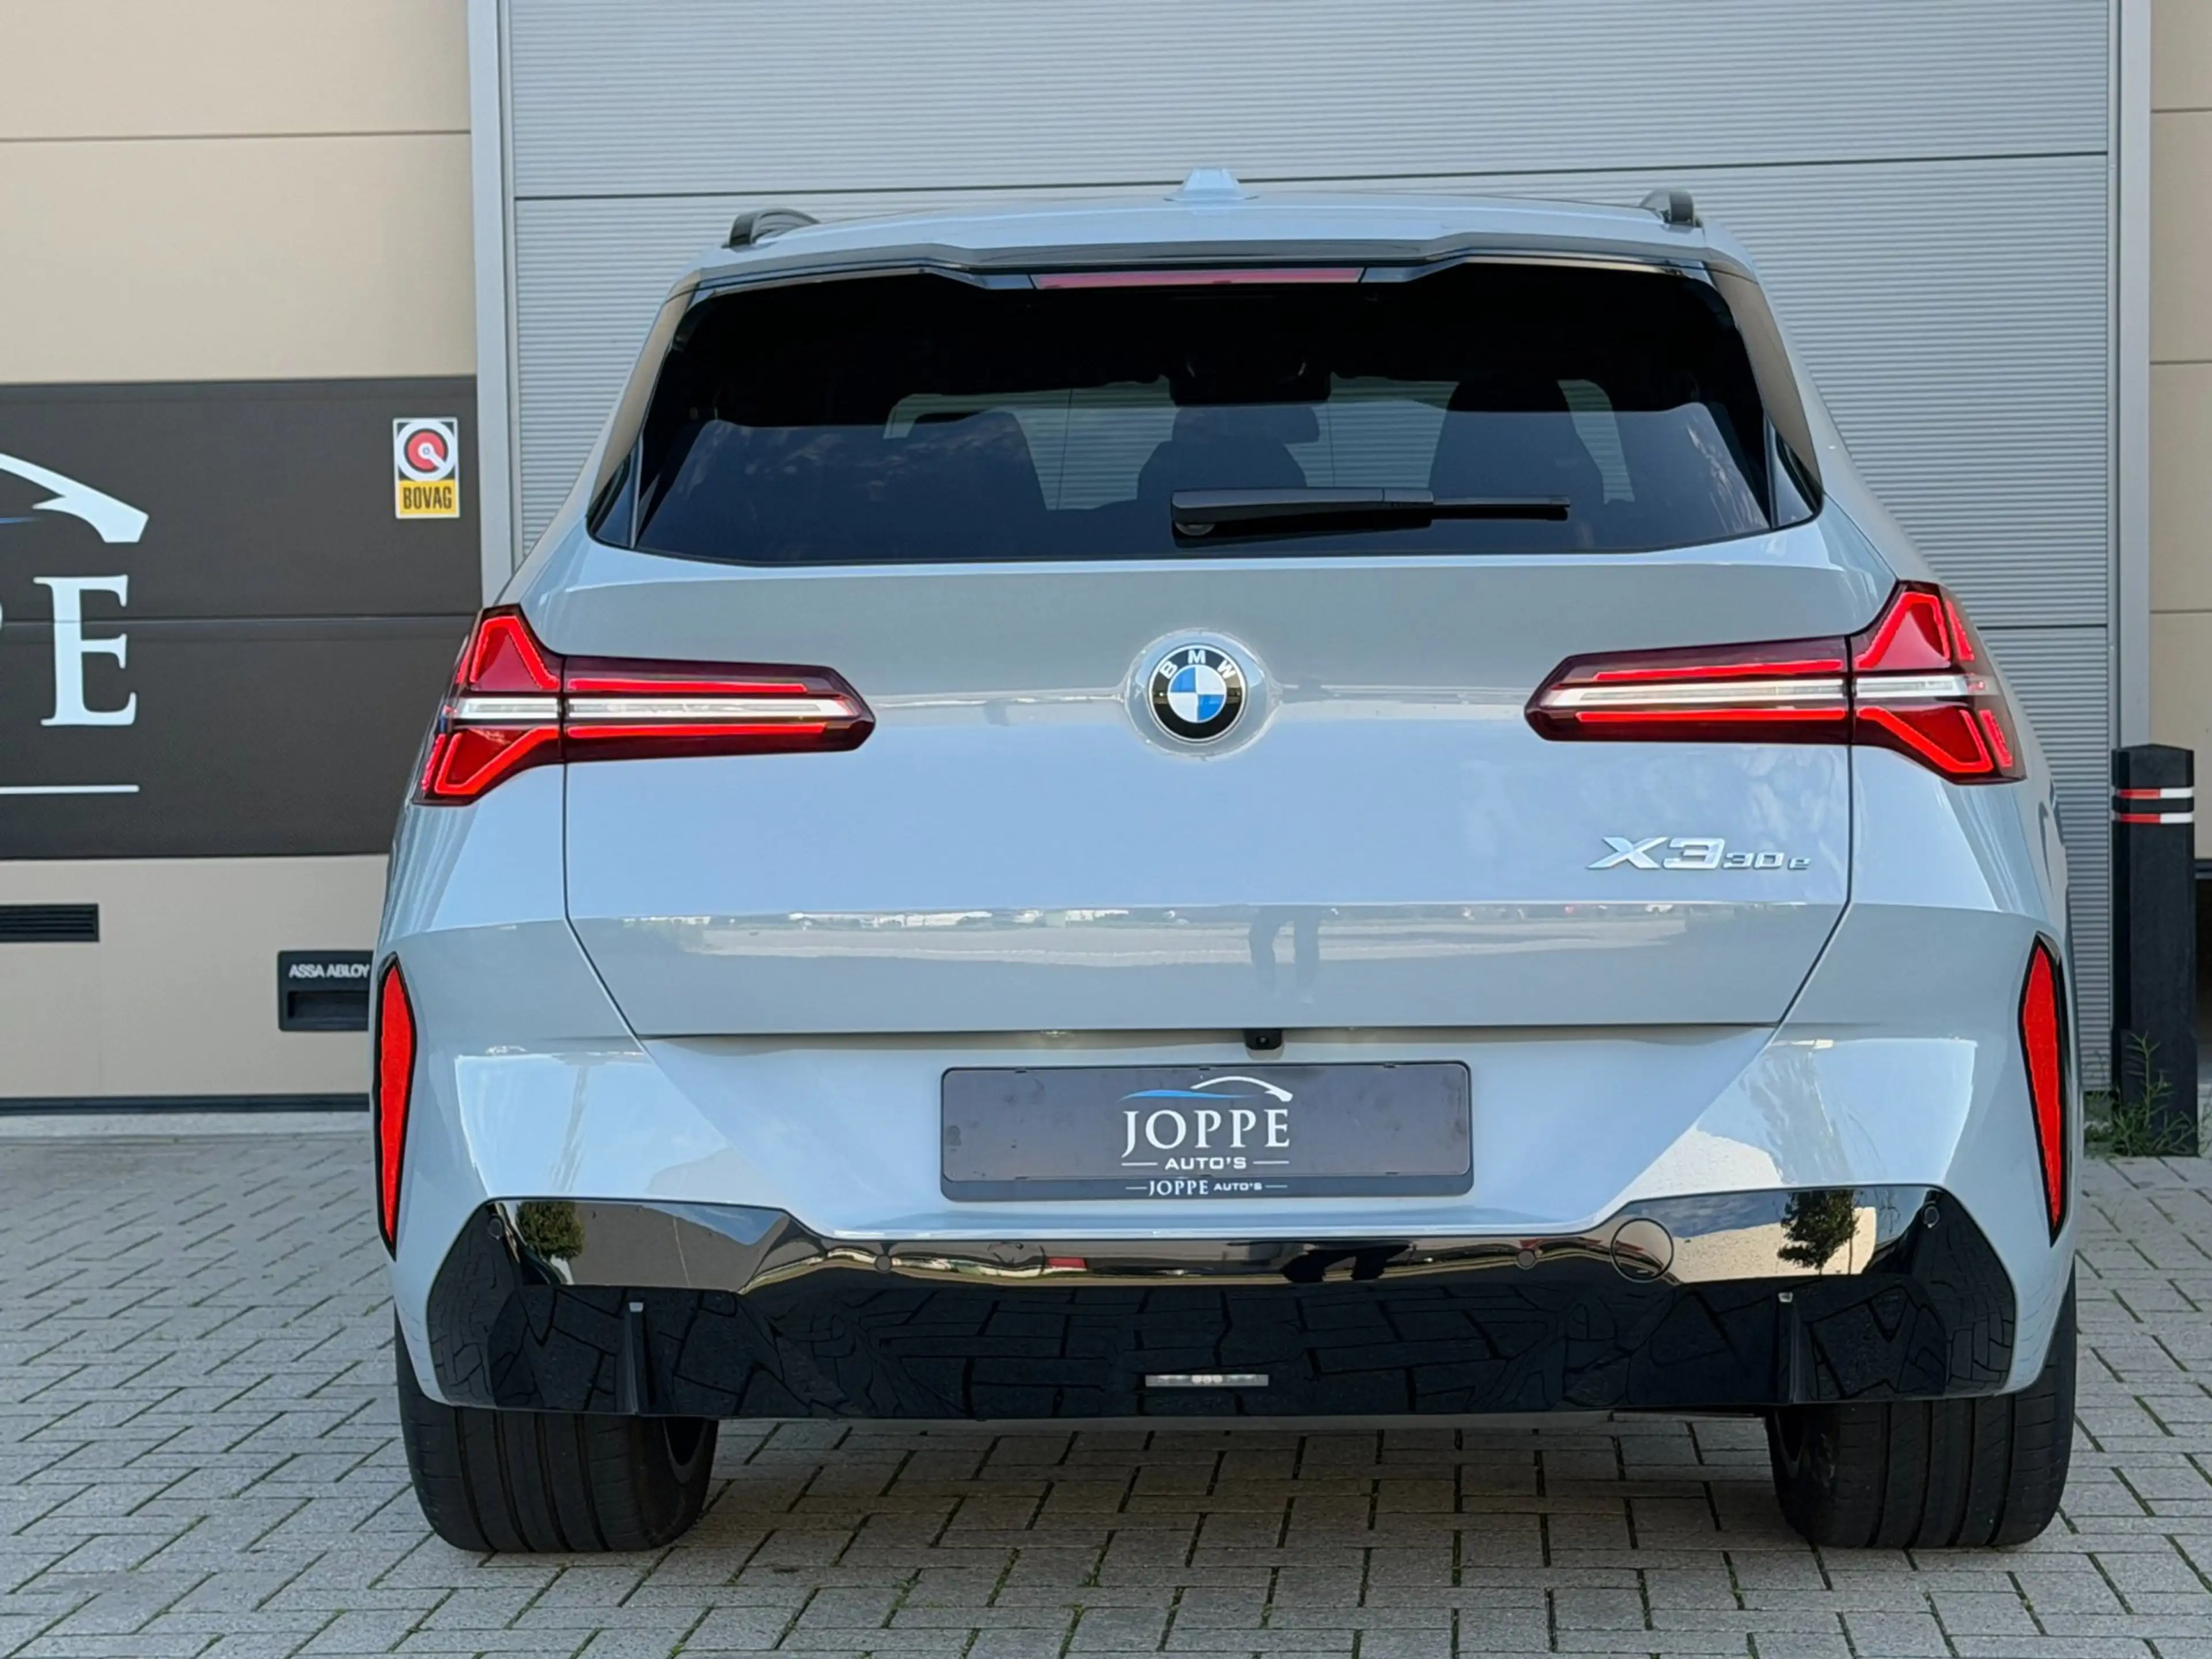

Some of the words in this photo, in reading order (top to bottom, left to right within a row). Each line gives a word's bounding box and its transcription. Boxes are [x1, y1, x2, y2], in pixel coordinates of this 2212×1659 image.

[403, 487, 452, 509] BOVAG
[0, 574, 138, 727] E
[1160, 650, 1237, 680] BMW
[289, 964, 325, 978] ASSA
[325, 964, 370, 978] ABLOY
[1121, 1108, 1291, 1158] JOPPE
[1165, 1156, 1247, 1170] AUTO'S
[1148, 1178, 1209, 1196] JOPPE
[1213, 1182, 1262, 1191] AUTO'S
